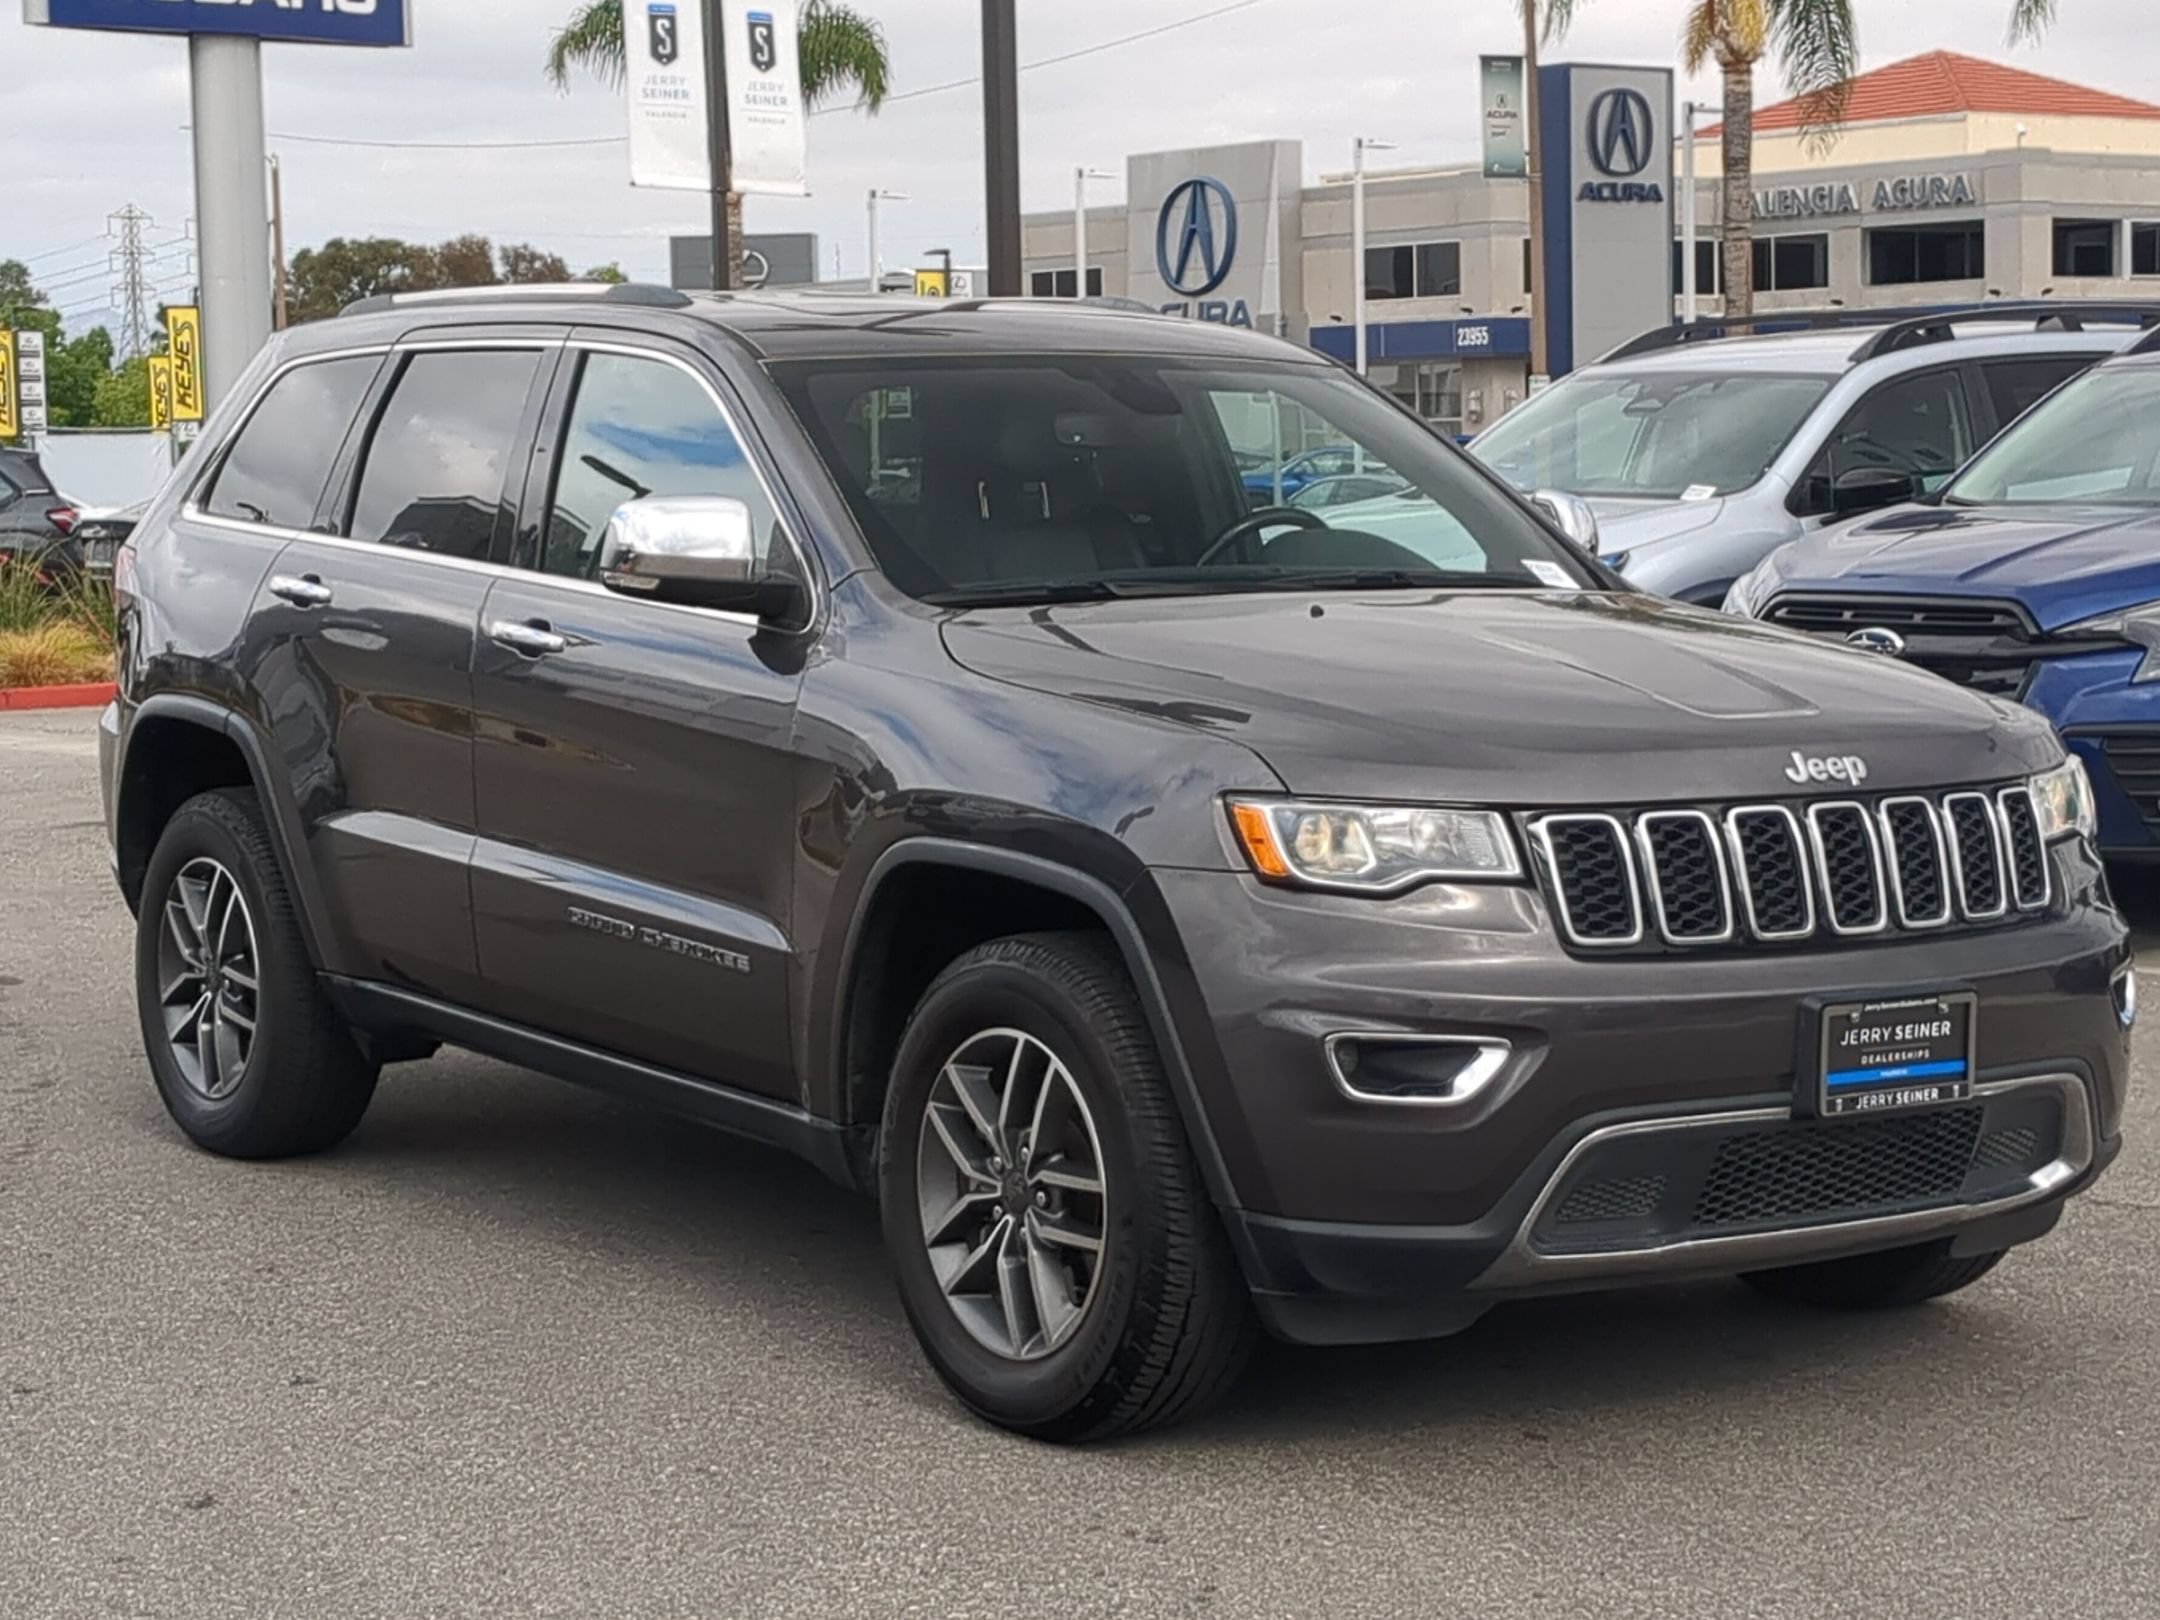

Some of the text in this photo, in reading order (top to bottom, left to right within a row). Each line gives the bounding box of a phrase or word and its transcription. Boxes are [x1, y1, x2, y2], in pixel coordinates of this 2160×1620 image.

[645, 75, 686, 86] JERRY
[747, 81, 785, 93] JERRY
[642, 88, 689, 99] SEINER
[745, 94, 788, 106] SEINER
[1487, 110, 1518, 119] ACURA
[1576, 181, 1664, 203] ACURA
[1749, 171, 1975, 219] ALENCIA ACURA
[1457, 326, 1489, 347] 23955
[172, 316, 196, 412] KEYES
[1785, 750, 1867, 787] Jeep
[1840, 1020, 1951, 1046] JERRY SEINER
[1861, 1049, 1930, 1065] DEALERSHIPS
[1856, 1087, 1939, 1109] JERRY SEINER
